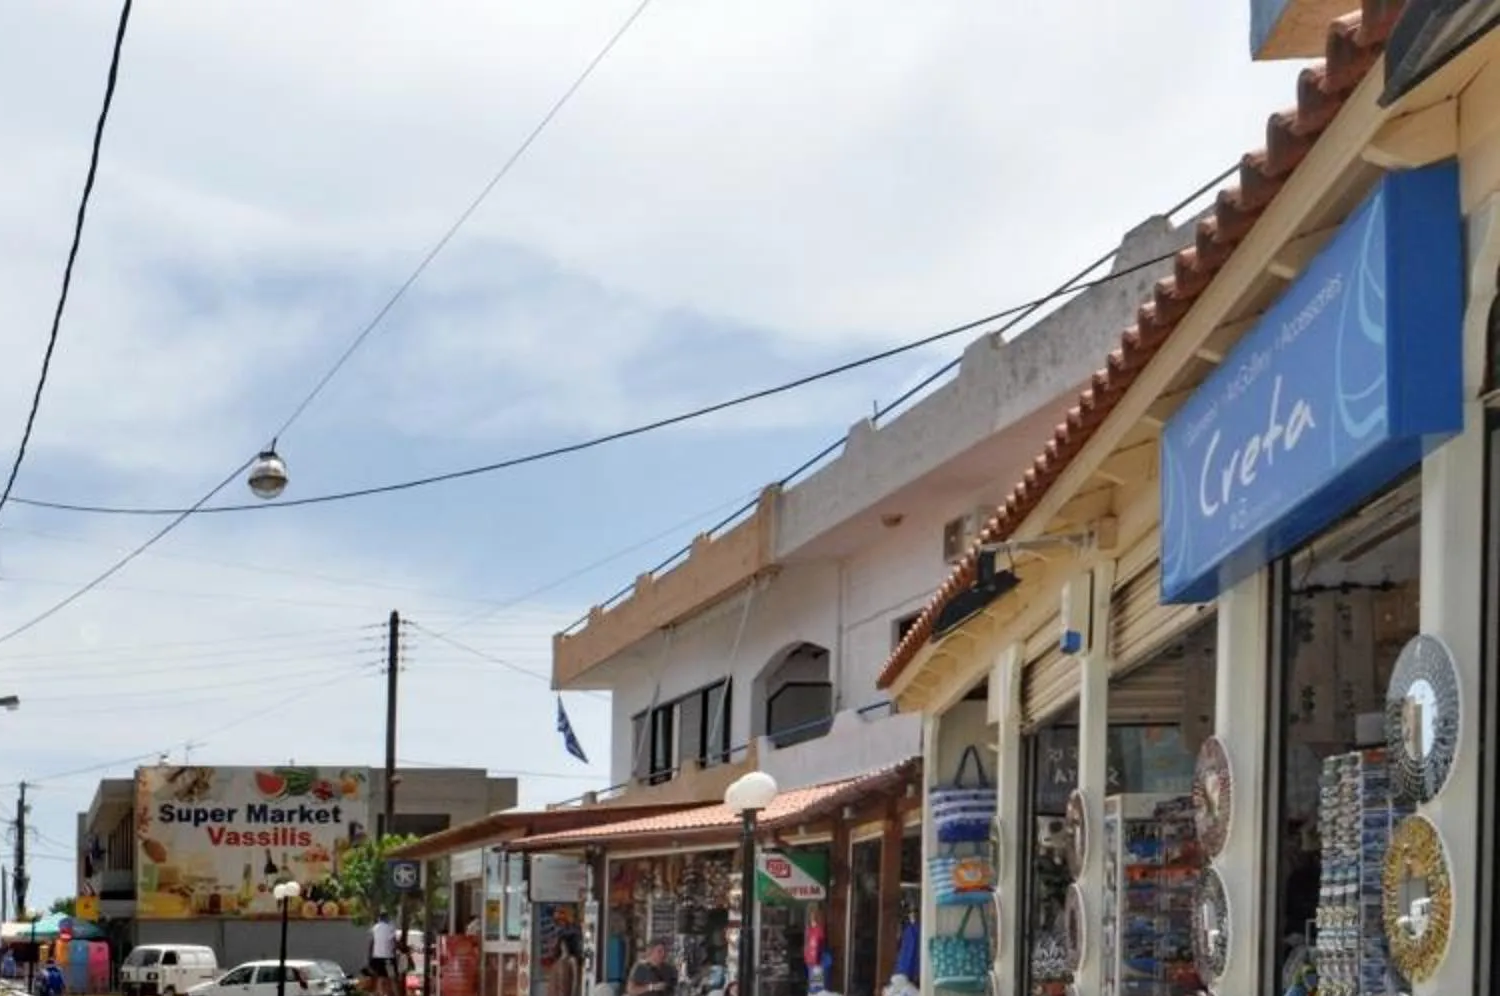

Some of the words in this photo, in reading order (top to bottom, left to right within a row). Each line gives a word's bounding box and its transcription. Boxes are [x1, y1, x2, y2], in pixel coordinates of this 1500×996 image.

[1200, 374, 1316, 517] Creta
[159, 804, 238, 827] Super
[246, 803, 342, 824] Market
[206, 826, 313, 847] Vassilis
